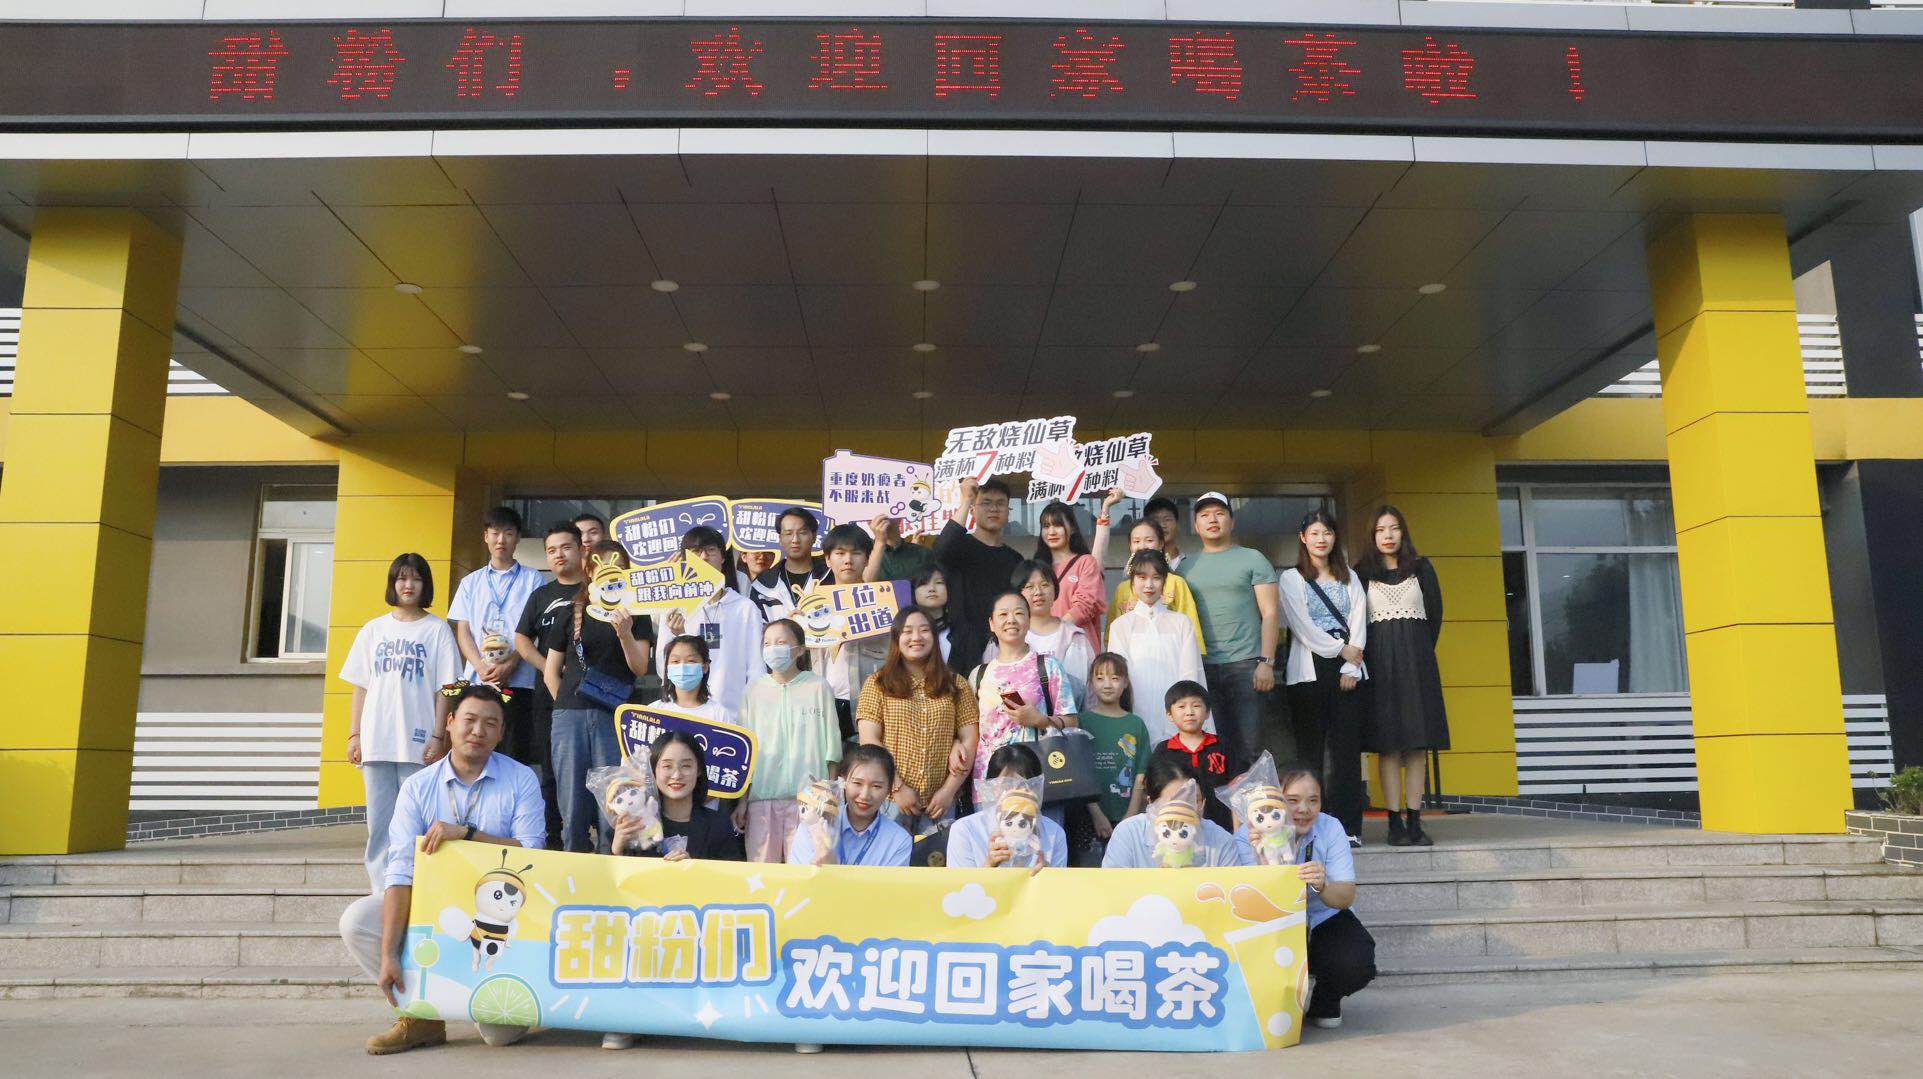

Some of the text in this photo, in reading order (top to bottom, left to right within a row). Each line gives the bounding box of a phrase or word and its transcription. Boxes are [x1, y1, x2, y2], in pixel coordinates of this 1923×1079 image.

[948, 419, 1072, 454] 无敌烧仙草
[1075, 436, 1148, 467] 烧仙草
[830, 471, 906, 487] 重度奶瘾者
[934, 450, 1036, 482] 满杯7种料
[829, 489, 890, 504] 不服来战
[625, 518, 676, 542] 甜粉们
[632, 535, 684, 557] 欢迎回
[630, 567, 674, 586] 甜粉们
[637, 581, 714, 602] 跟我向前冲
[847, 607, 893, 635] 出道
[629, 719, 668, 745] 甜粉
[553, 907, 773, 984] 甜粉们
[785, 944, 1221, 1021] 欢迎回家喝茶
